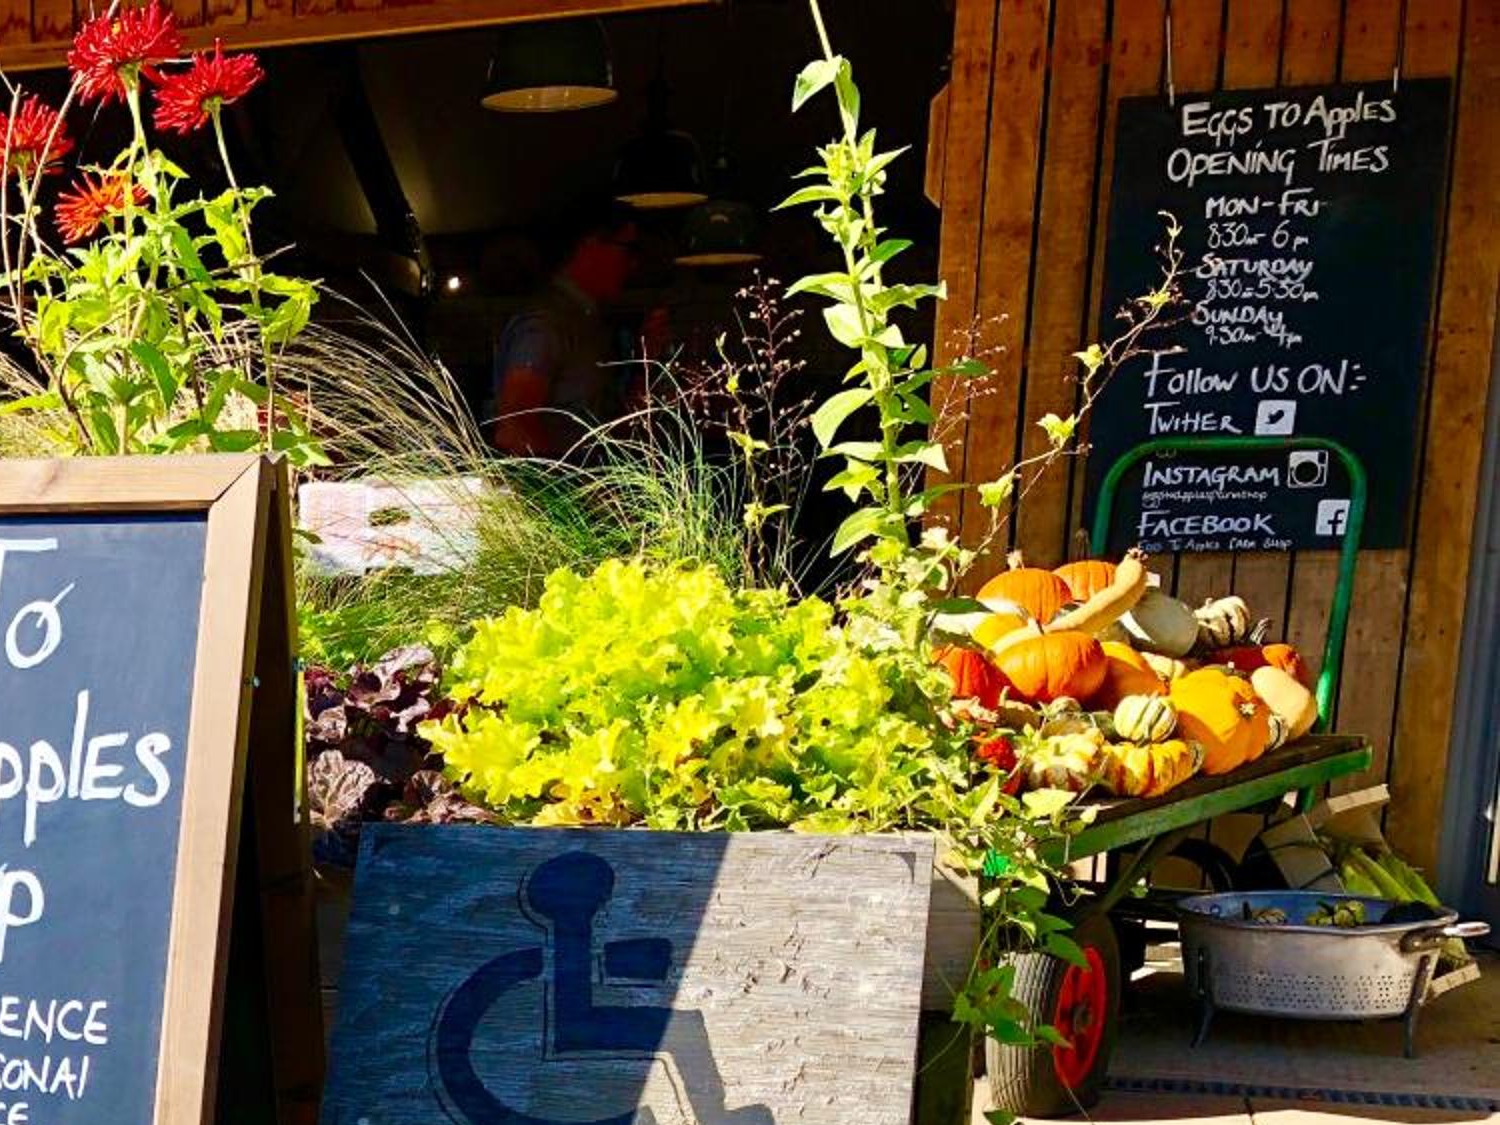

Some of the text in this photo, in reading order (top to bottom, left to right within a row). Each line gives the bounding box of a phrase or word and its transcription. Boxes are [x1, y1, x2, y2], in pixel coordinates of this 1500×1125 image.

[1182, 101, 1253, 147] EGGS
[1264, 101, 1301, 130] TO
[1167, 136, 1389, 188] OPENING TIMES
[1196, 252, 1314, 283] SATURDAY
[1192, 299, 1284, 331] SUNDAY
[1250, 364, 1290, 392] US
[1143, 462, 1280, 491] INSTAGRAM
[1137, 510, 1275, 536] FACEBOOK
